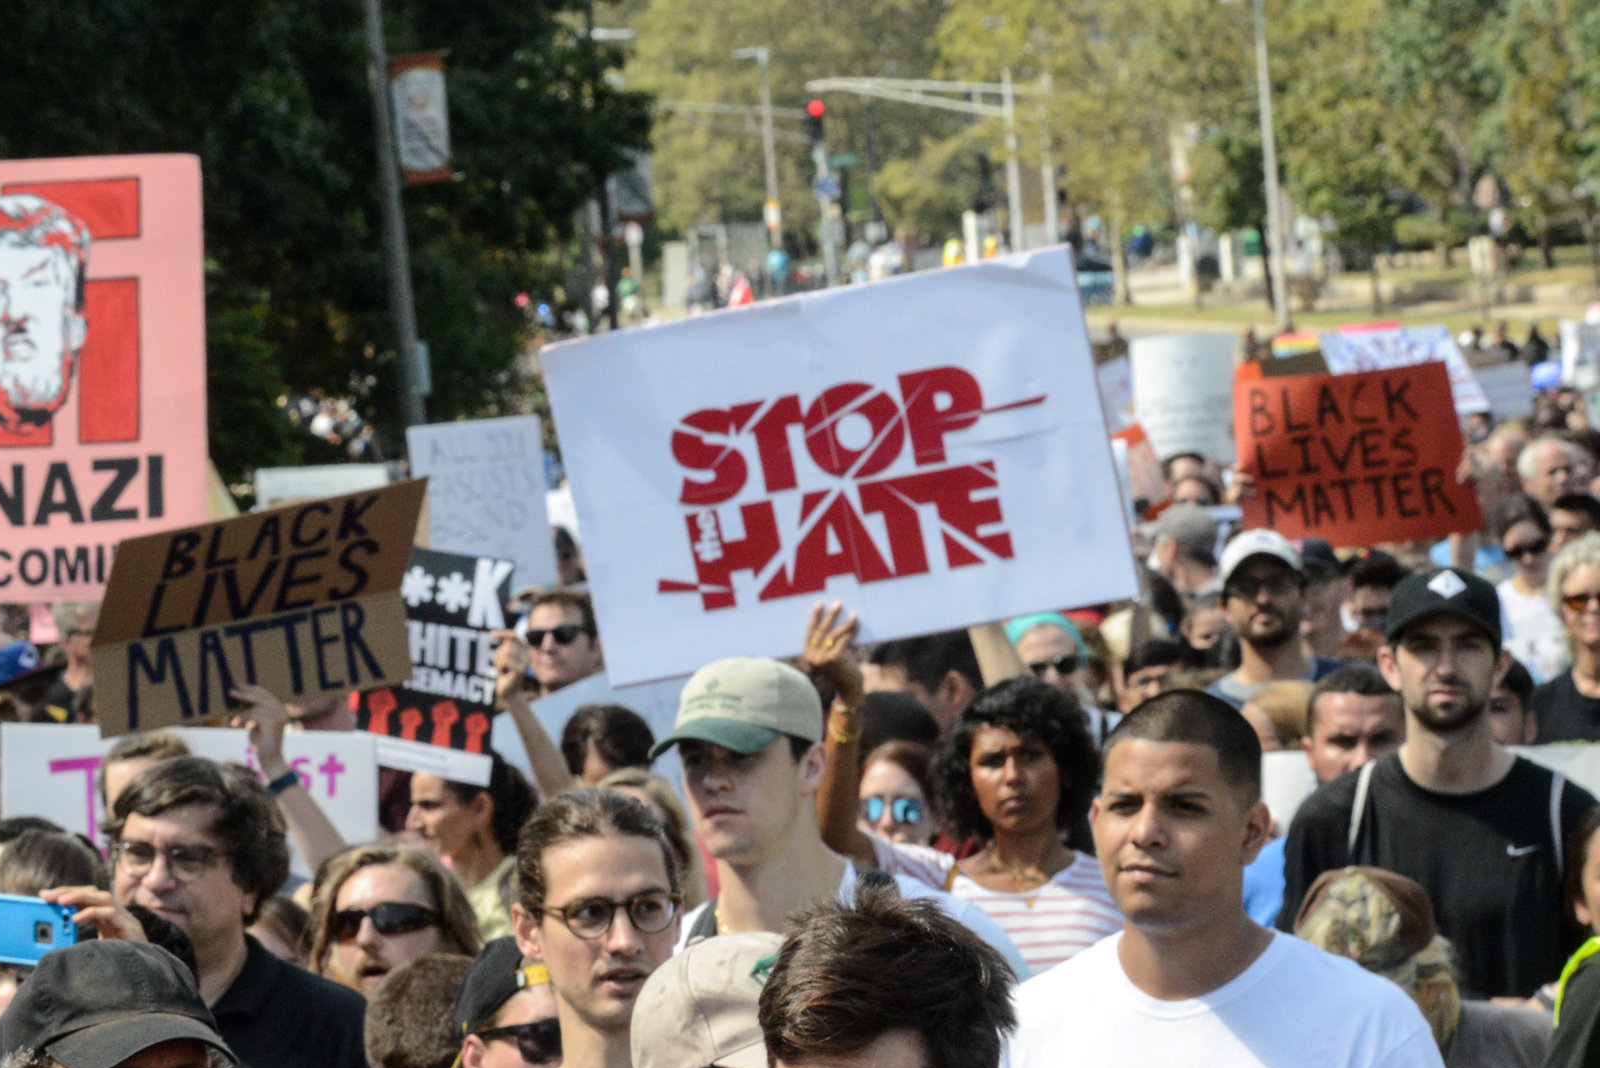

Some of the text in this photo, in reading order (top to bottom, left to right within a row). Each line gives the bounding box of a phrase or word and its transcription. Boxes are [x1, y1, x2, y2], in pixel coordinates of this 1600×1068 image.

[671, 366, 984, 506] STOP
[1250, 378, 1420, 437] BLACK
[1256, 427, 1420, 480] LIVES
[162, 494, 384, 581] BLACK
[685, 459, 1016, 613] HATE
[1264, 468, 1457, 529] MATTER
[141, 539, 381, 638] LIVES
[127, 603, 387, 730] MATTER
[405, 619, 500, 678] HITE
